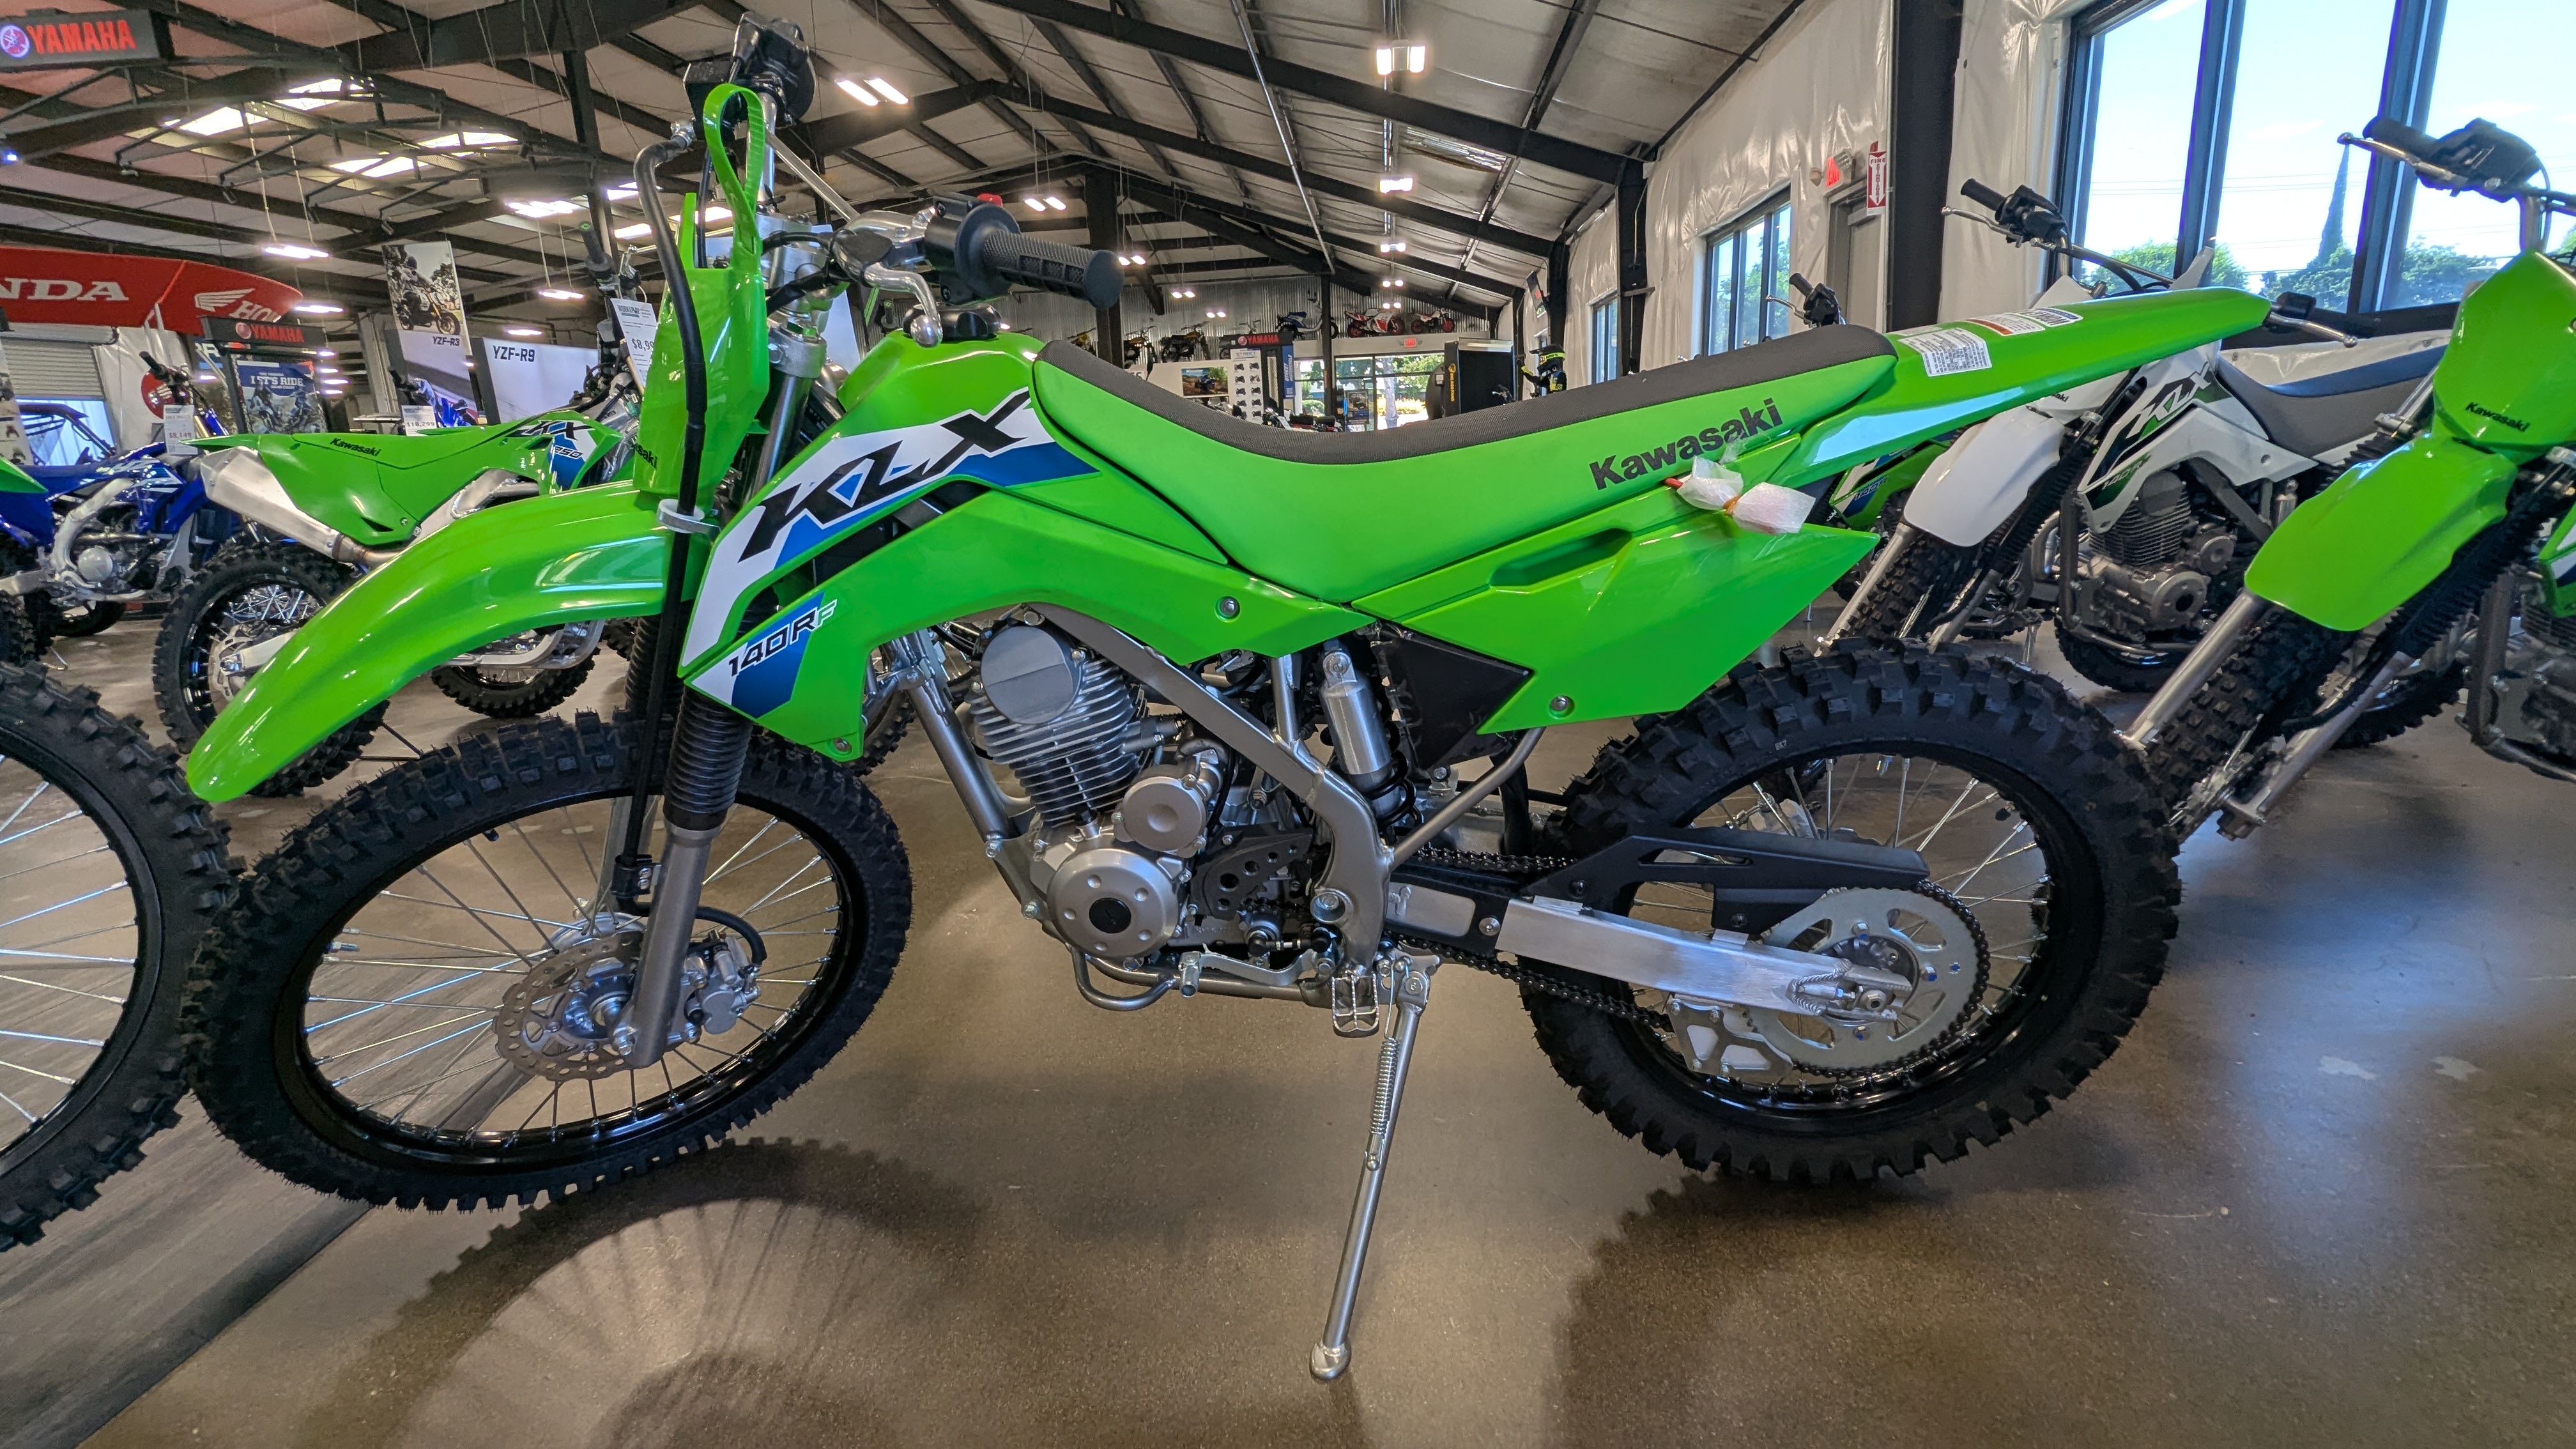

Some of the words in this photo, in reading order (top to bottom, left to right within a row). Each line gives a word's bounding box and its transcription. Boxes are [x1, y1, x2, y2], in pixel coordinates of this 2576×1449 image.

[26, 20, 137, 54] YAMAHA
[250, 324, 304, 342] YAMAHA
[433, 336, 460, 346] YZF-R3
[1248, 334, 1280, 344] YAMAHA
[493, 345, 535, 362] YZF-R9
[280, 377, 303, 387] RIDE
[2125, 362, 2211, 439] KLX
[2465, 402, 2531, 432] Kawasaki
[523, 420, 595, 441] KX
[330, 438, 382, 457] Kawasaki
[553, 446, 584, 459] 250
[1589, 397, 1783, 490] Kawasaki
[737, 390, 1029, 564] KLX
[728, 599, 838, 677] 140RF
